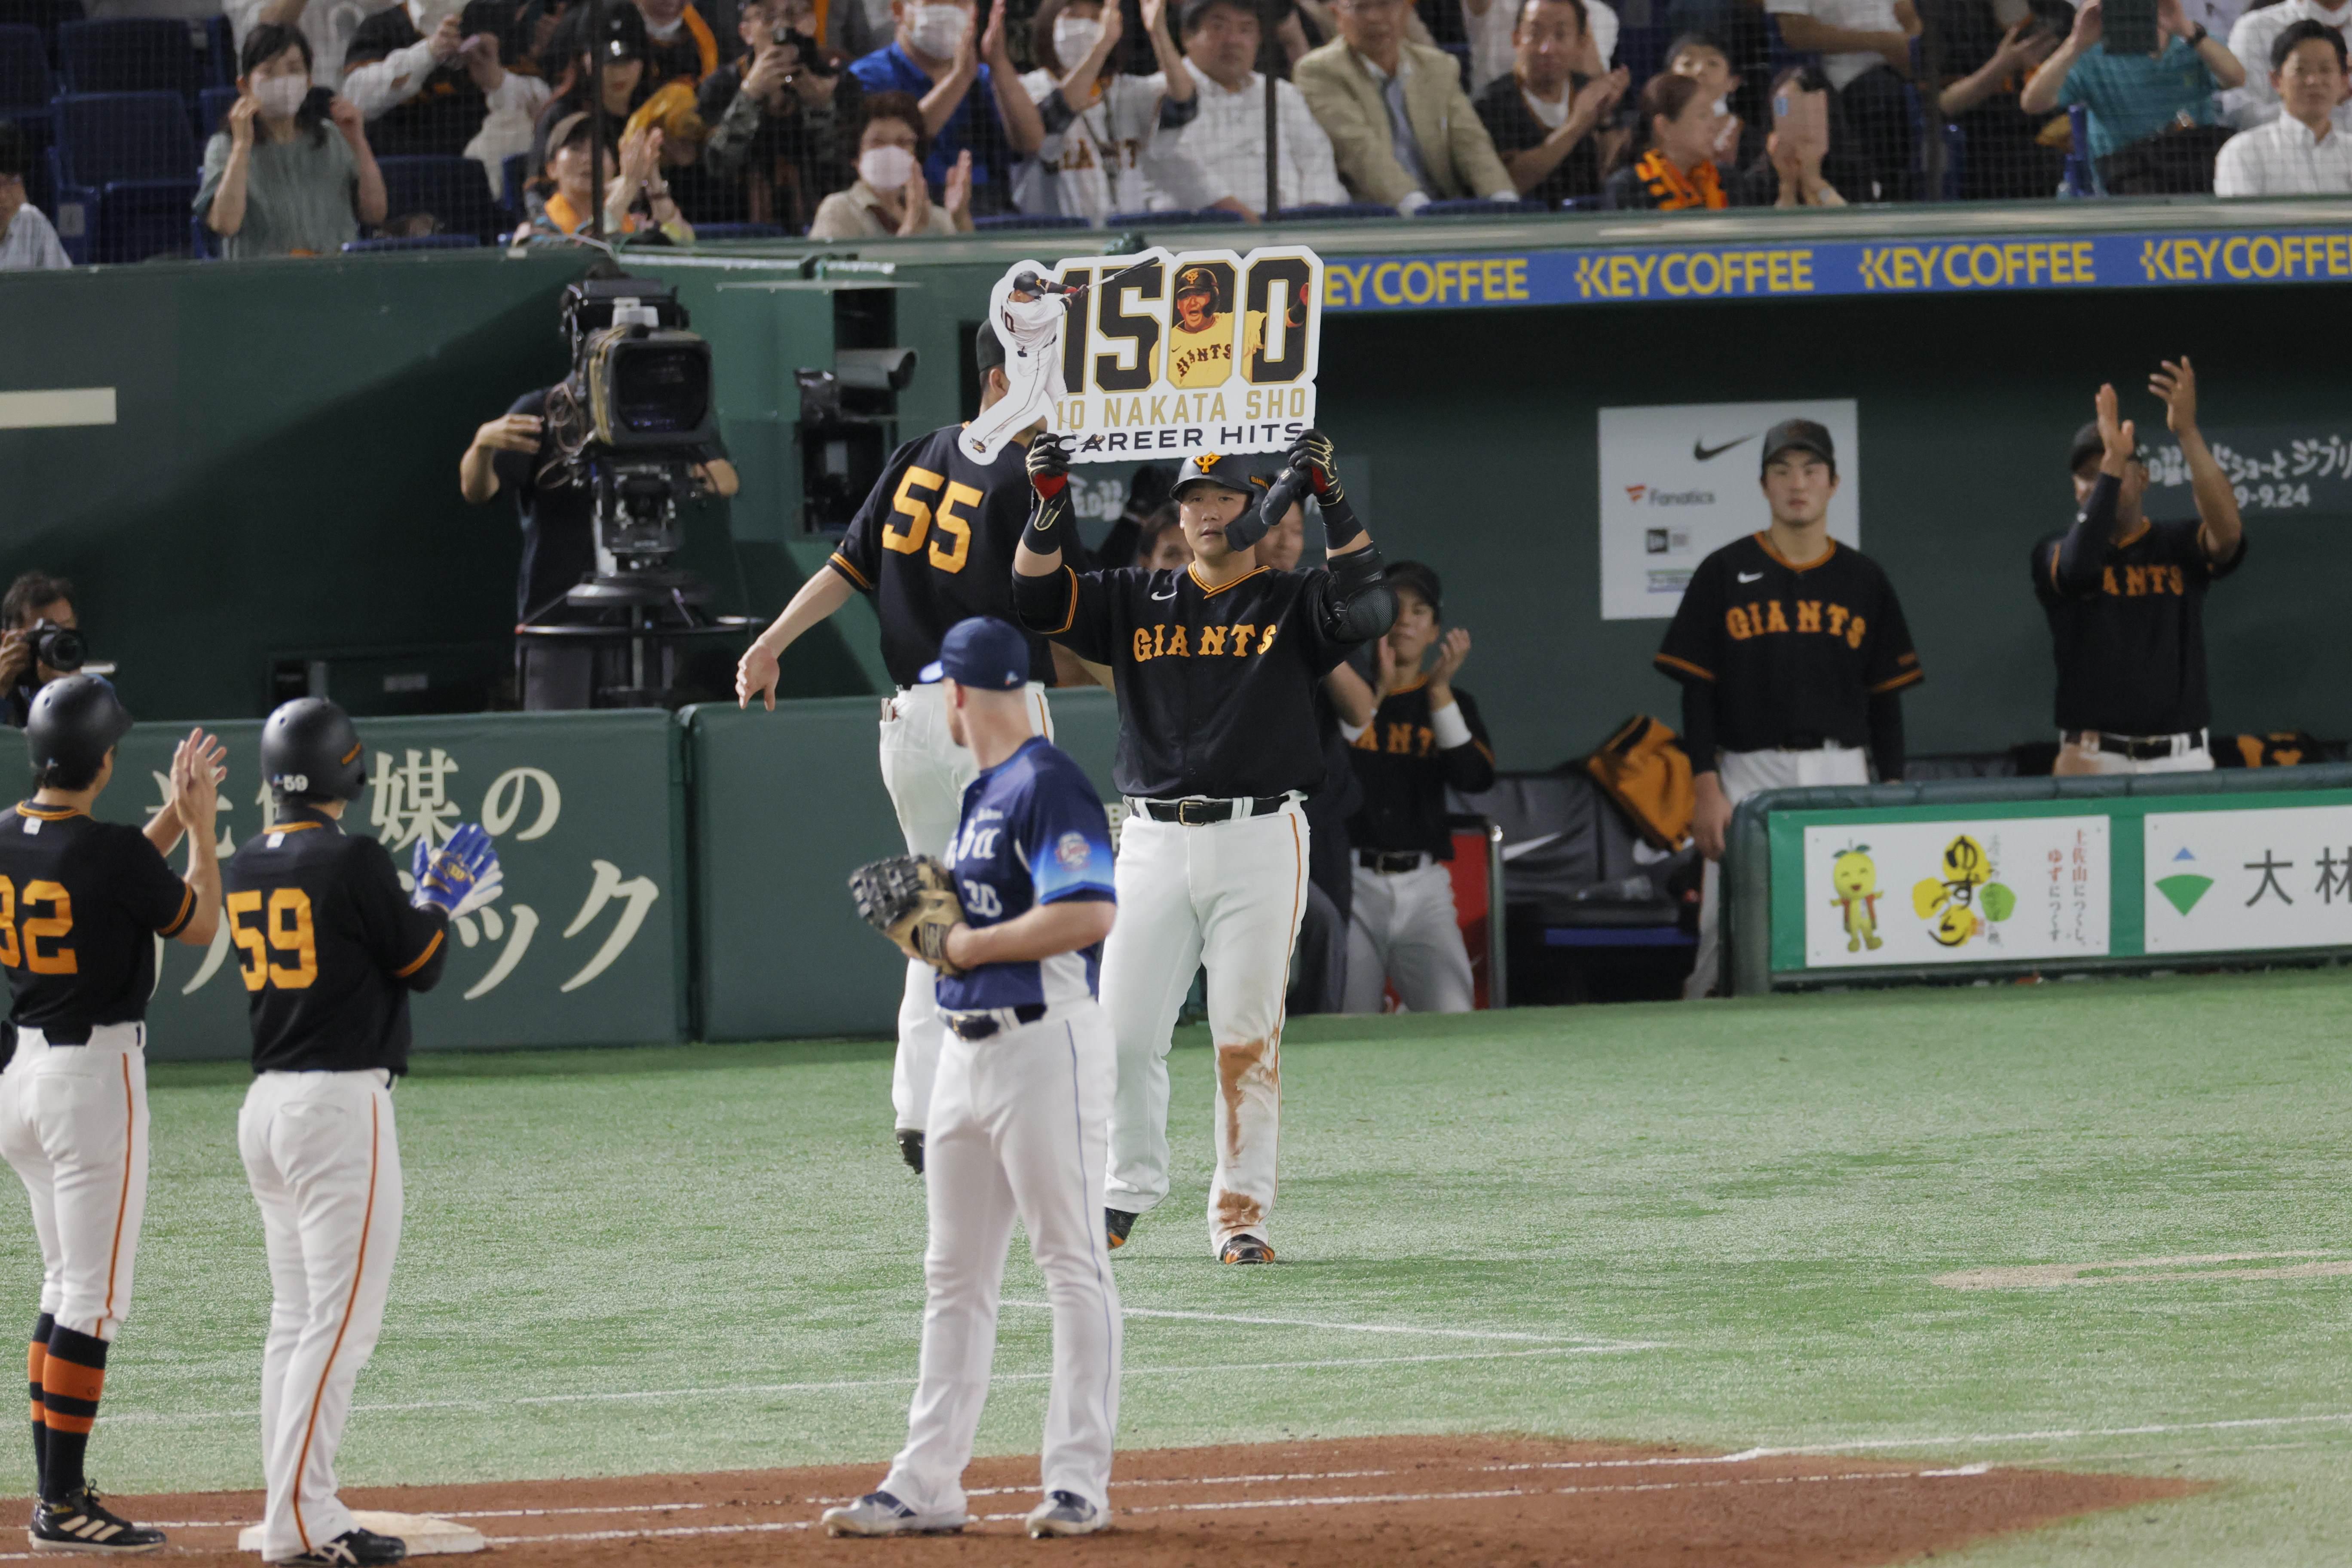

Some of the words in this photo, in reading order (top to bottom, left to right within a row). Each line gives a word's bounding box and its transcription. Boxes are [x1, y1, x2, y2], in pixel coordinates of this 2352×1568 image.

[1060, 256, 1313, 396] 1500
[1176, 343, 1231, 377] GIANTS
[1057, 400, 1085, 430] 10
[1103, 392, 1227, 428] NAKATA
[1246, 387, 1305, 420] SHO
[1056, 428, 1204, 454] CAREER
[1221, 422, 1304, 445] HITS
[1650, 487, 1716, 506] Fanatics
[882, 465, 984, 574] 55
[2103, 564, 2184, 597] ANTS
[1133, 623, 1277, 662] GIANTS
[1726, 600, 1866, 649] GIANTS
[283, 774, 309, 792] 59
[227, 887, 318, 992] 59
